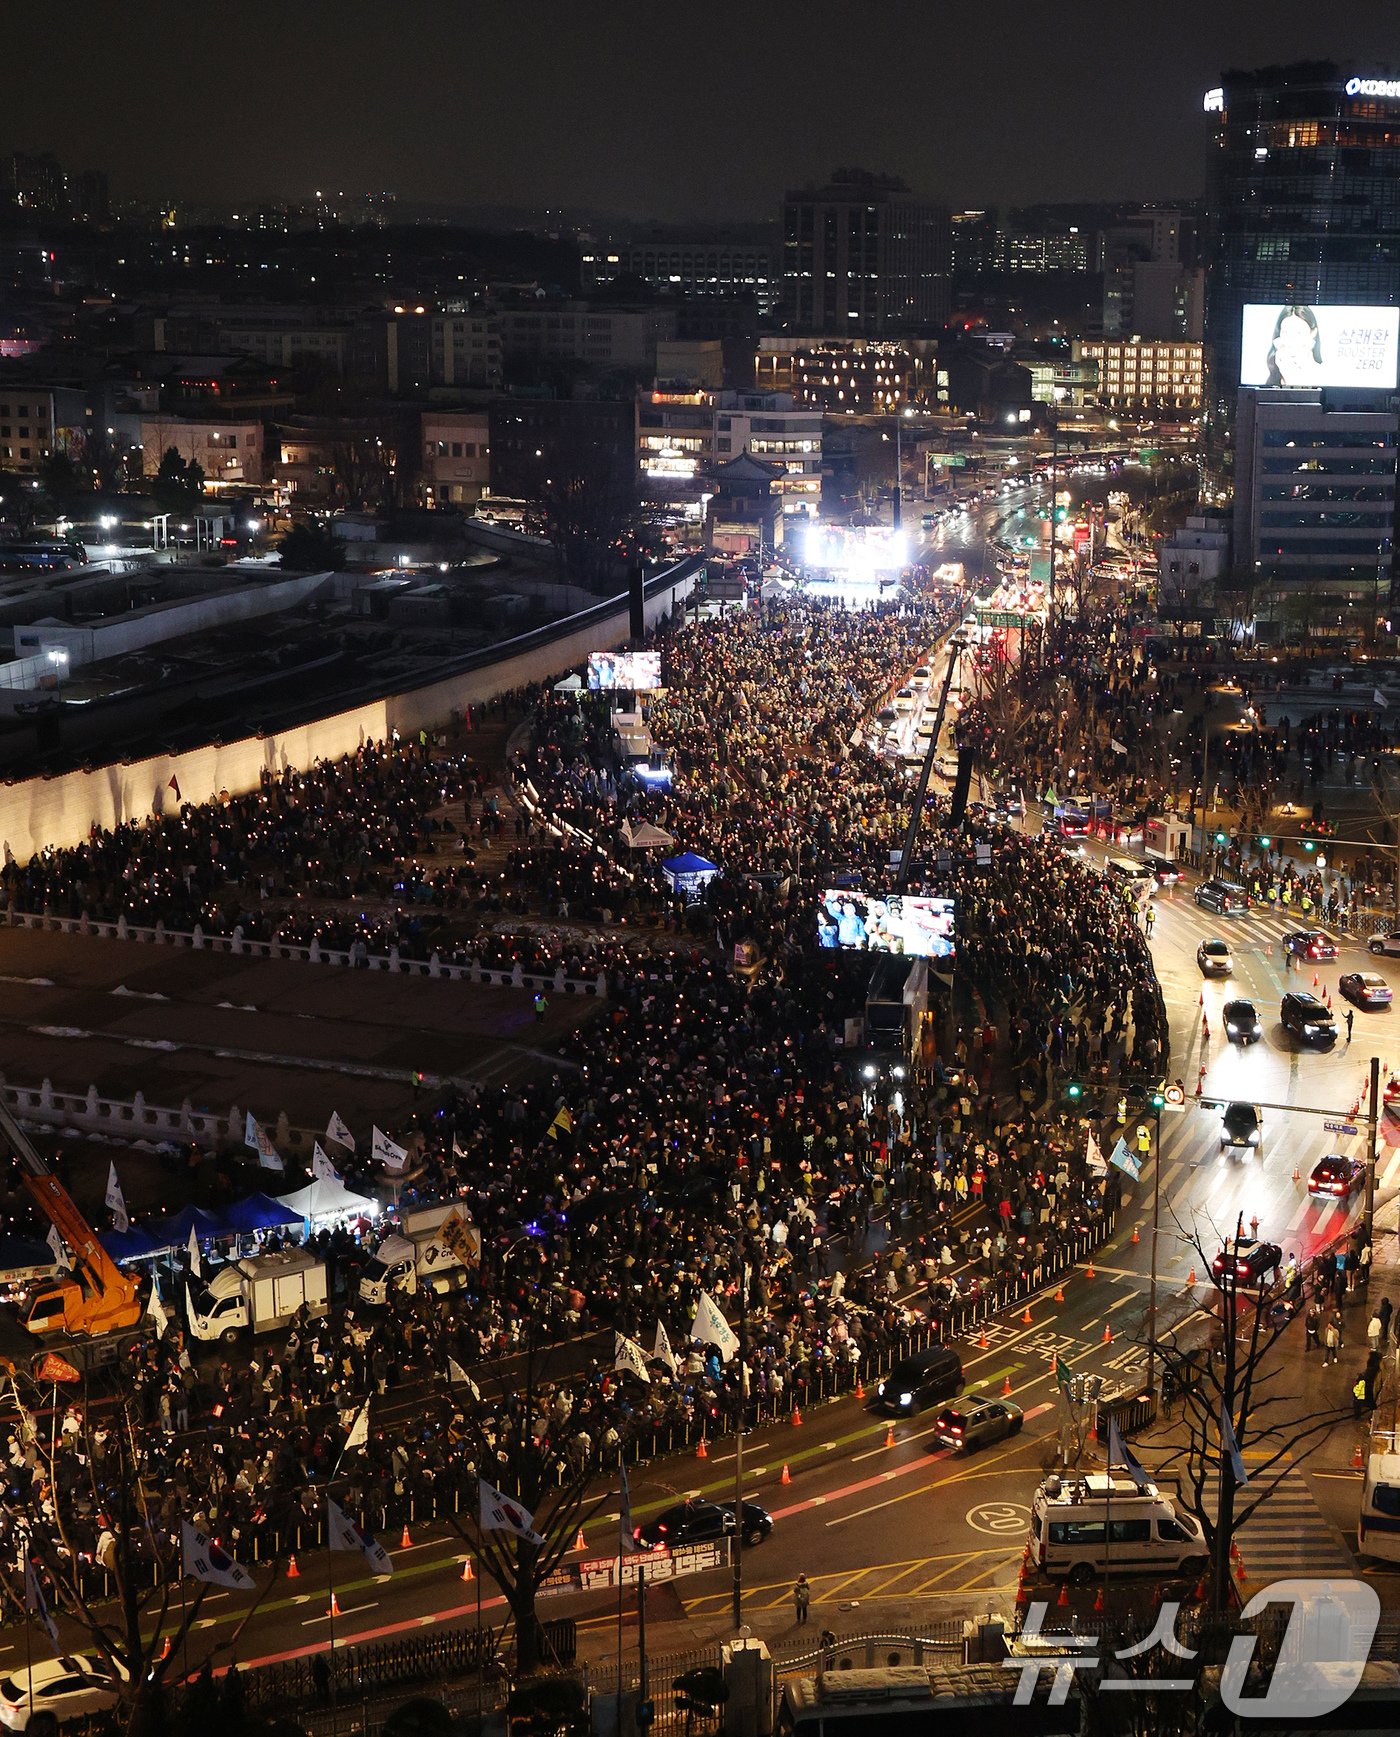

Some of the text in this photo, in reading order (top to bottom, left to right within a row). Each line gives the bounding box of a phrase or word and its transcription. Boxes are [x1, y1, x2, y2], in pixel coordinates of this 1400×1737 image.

[1339, 328, 1389, 346] 상쾌환
[1337, 347, 1386, 358] BOOSTER
[1355, 359, 1384, 370] ZERO
[978, 1507, 1026, 1530] 20
